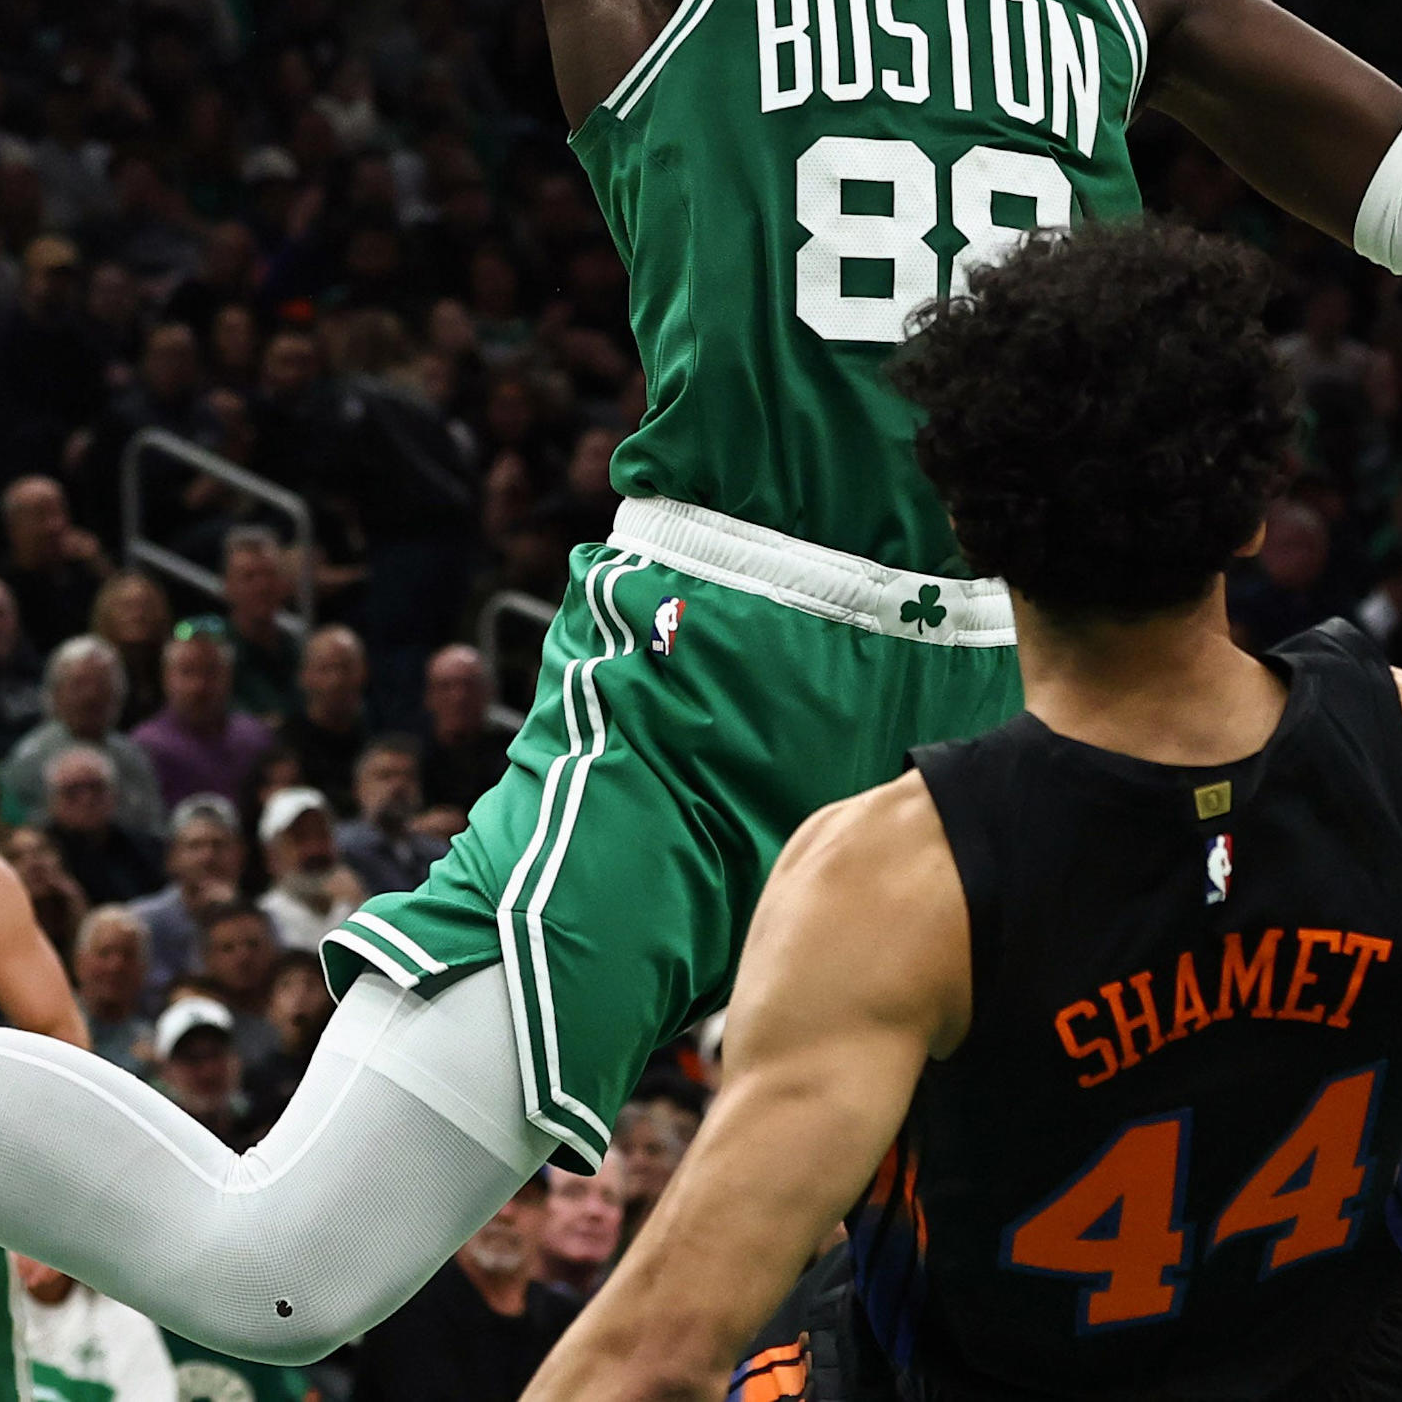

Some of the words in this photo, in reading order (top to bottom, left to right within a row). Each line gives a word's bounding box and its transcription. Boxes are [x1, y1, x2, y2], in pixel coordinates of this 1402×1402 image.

[796, 136, 1073, 344] 88
[1054, 927, 1394, 1088] SHAMET
[1001, 1060, 1386, 1336] 44
